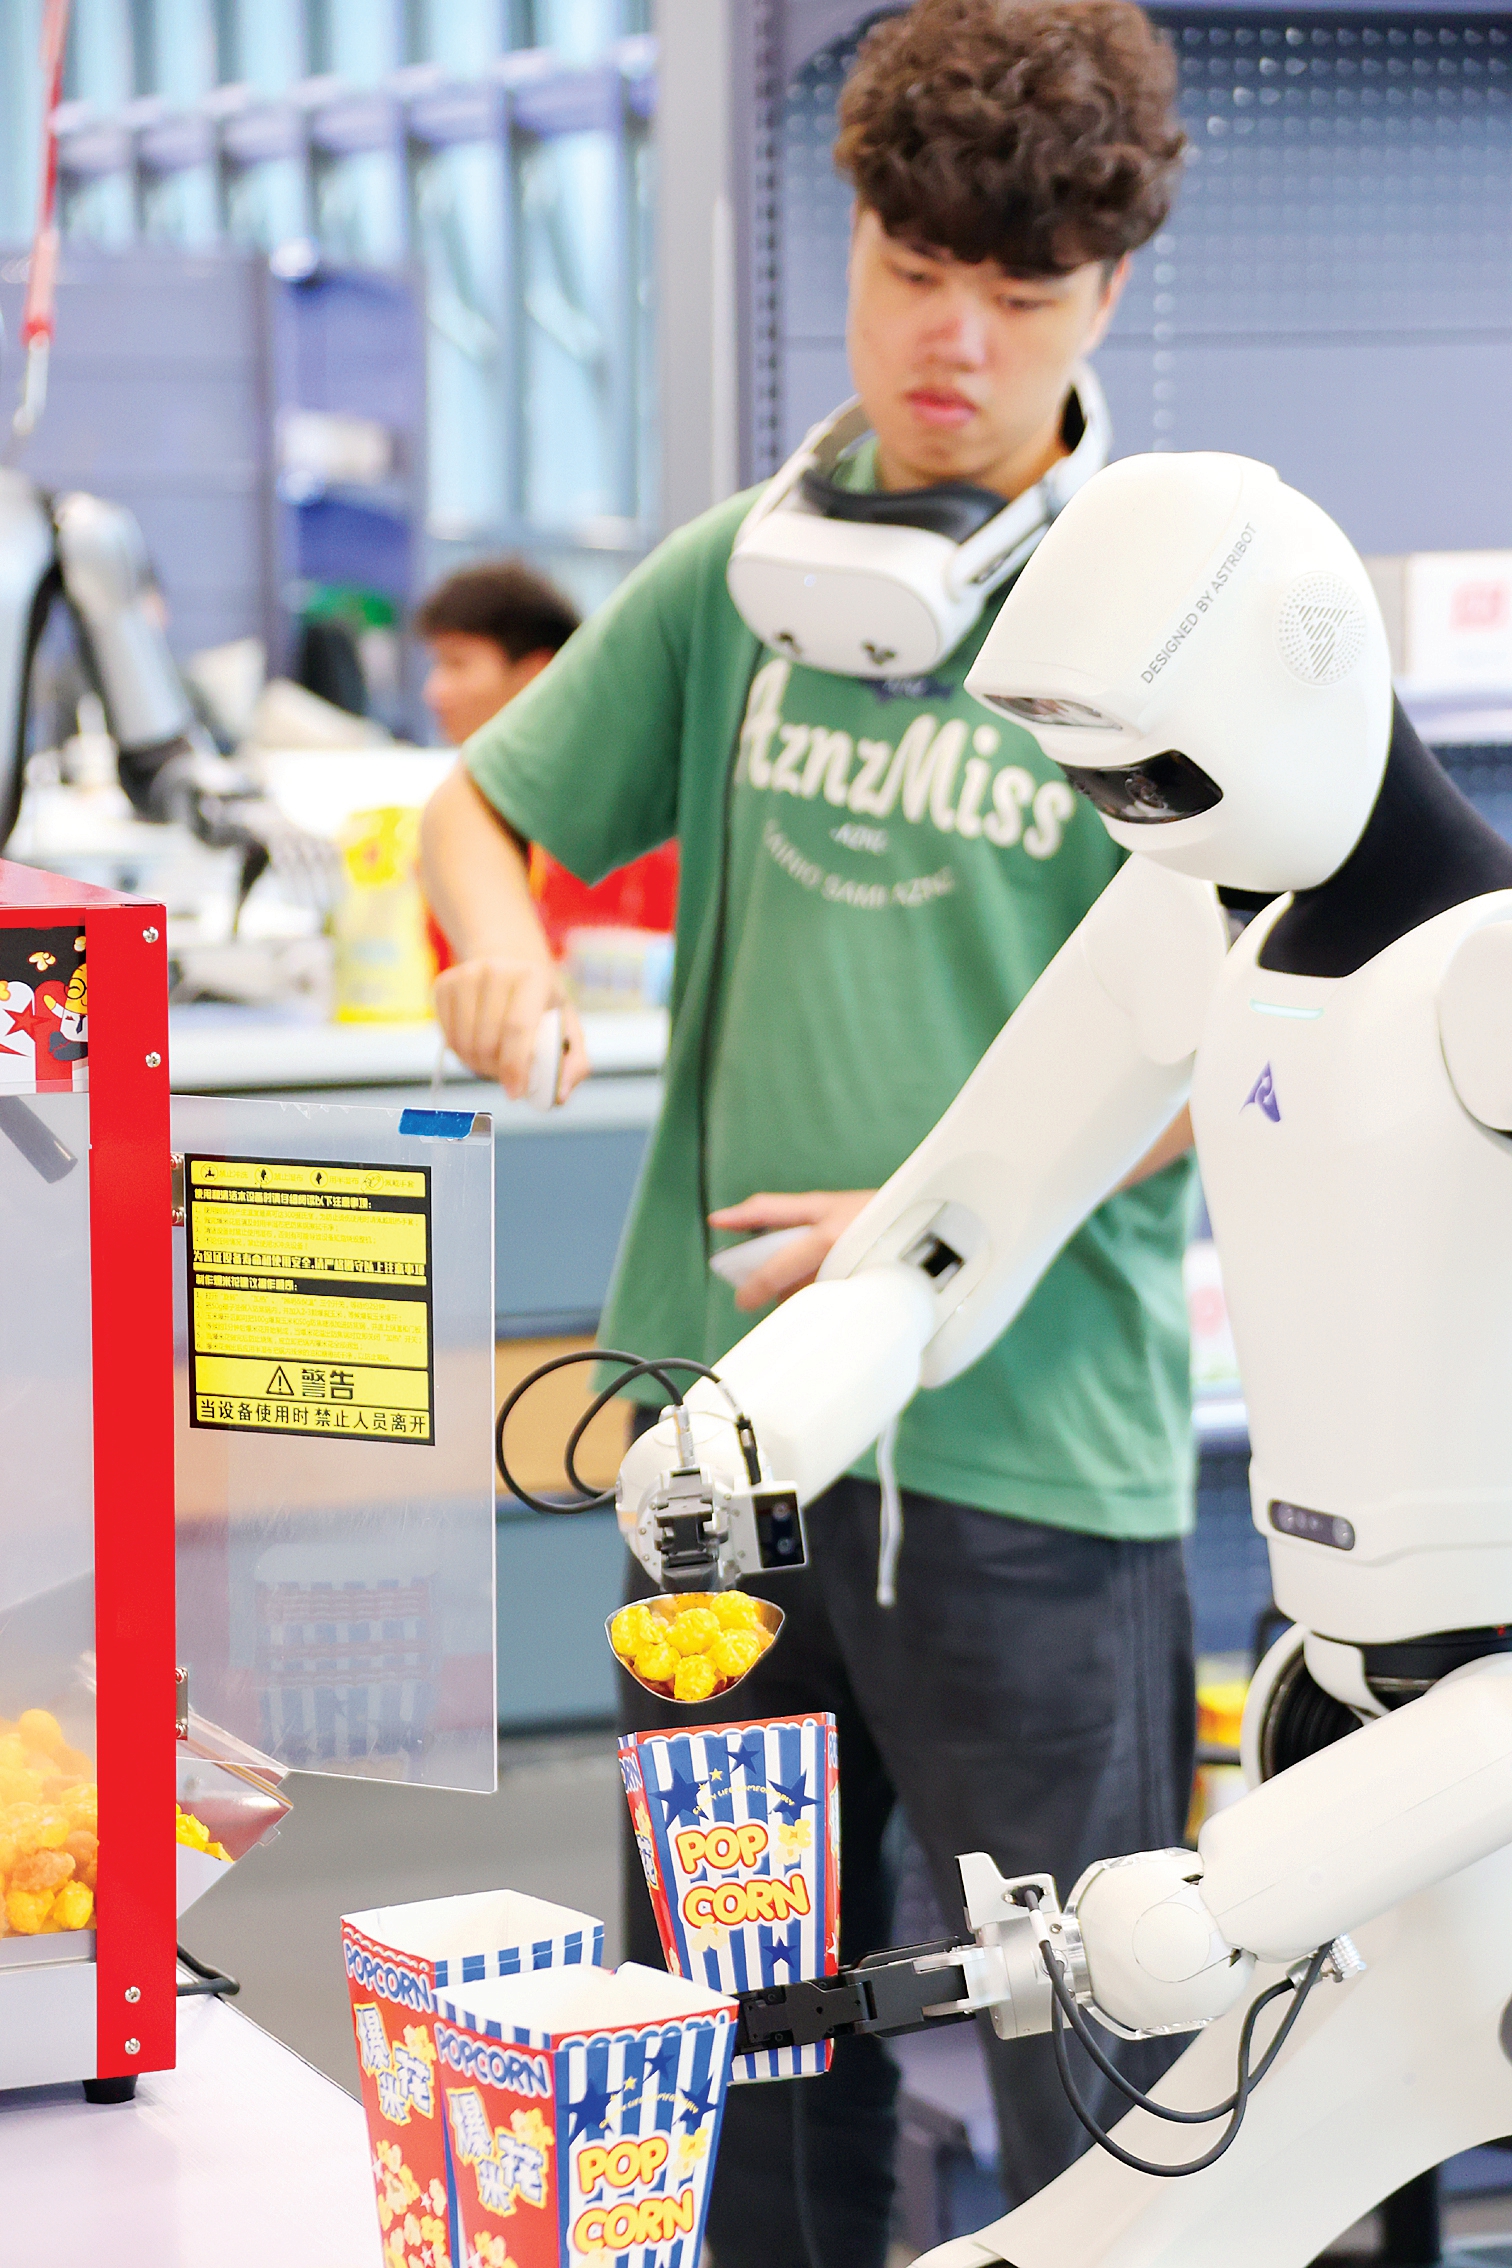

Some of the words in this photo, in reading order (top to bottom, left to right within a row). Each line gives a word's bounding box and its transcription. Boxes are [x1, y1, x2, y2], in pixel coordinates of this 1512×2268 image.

[1140, 612, 1199, 684] DESIGNED
[1195, 590, 1215, 613] BY
[1210, 521, 1257, 595] ASTRIBOT
[301, 1368, 355, 1400] 警告
[718, 1787, 733, 1797] LIFE
[675, 1824, 769, 1874] POP
[683, 1873, 811, 1930] CORN
[344, 1944, 431, 2012] POPCORN
[436, 2024, 549, 2096] POPCORN
[577, 2136, 668, 2194] POP
[573, 2189, 694, 2254] CORN
